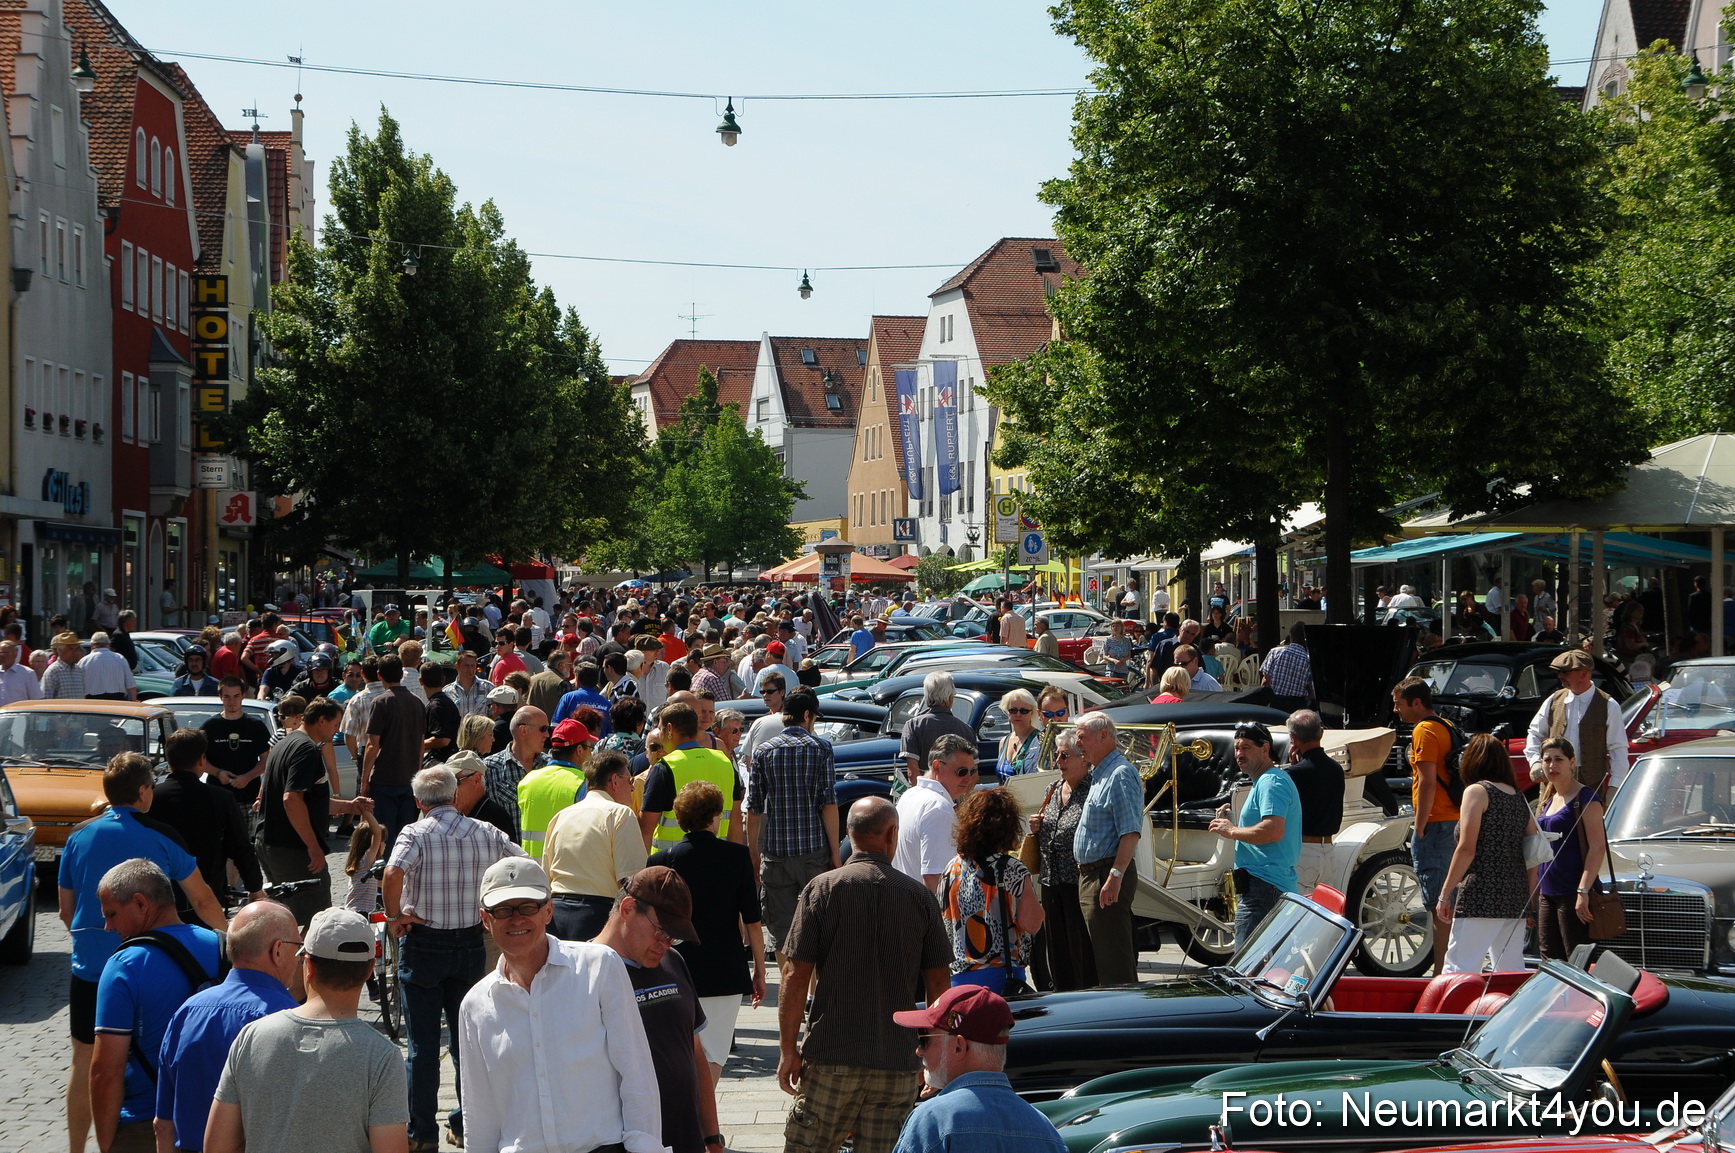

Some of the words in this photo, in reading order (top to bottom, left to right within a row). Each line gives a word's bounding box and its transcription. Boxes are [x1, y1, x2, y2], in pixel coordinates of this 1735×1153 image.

[197, 279, 227, 448] HOTEL
[946, 411, 956, 460] RUPPERT
[200, 465, 224, 473] Stern
[648, 987, 679, 1000] ACADEMY
